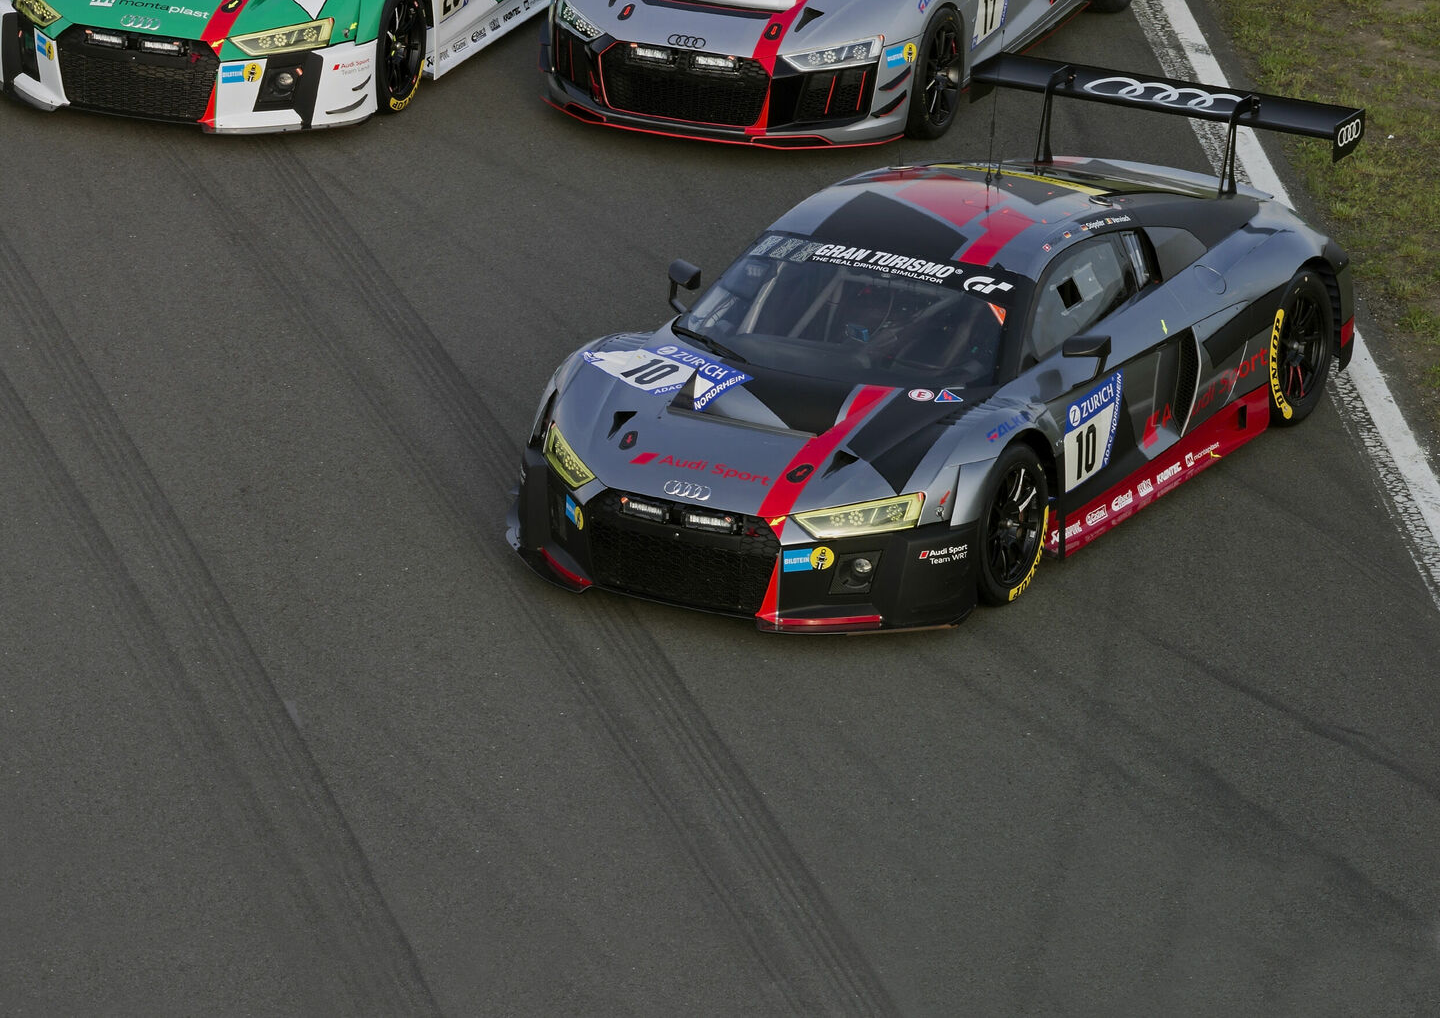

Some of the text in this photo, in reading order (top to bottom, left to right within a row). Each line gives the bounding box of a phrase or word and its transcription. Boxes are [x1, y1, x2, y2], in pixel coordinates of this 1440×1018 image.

[811, 255, 944, 285] THE REAL DRIVING SIMULATOR
[814, 243, 957, 279] GRAN TURISMO
[620, 358, 680, 385] 10
[675, 351, 729, 380] ZURICH
[1271, 317, 1284, 408] DUNLOP
[654, 374, 746, 411] ADAC NORDRHEIN
[1079, 382, 1114, 419] ZURICH
[1103, 372, 1122, 464] ADAC NORDRHEIN
[1075, 423, 1098, 481] 10
[658, 455, 772, 486] Audi Sport
[784, 556, 810, 565] BILSTEIN
[930, 544, 968, 557] Audi Sport
[930, 551, 968, 565] Team WRT
